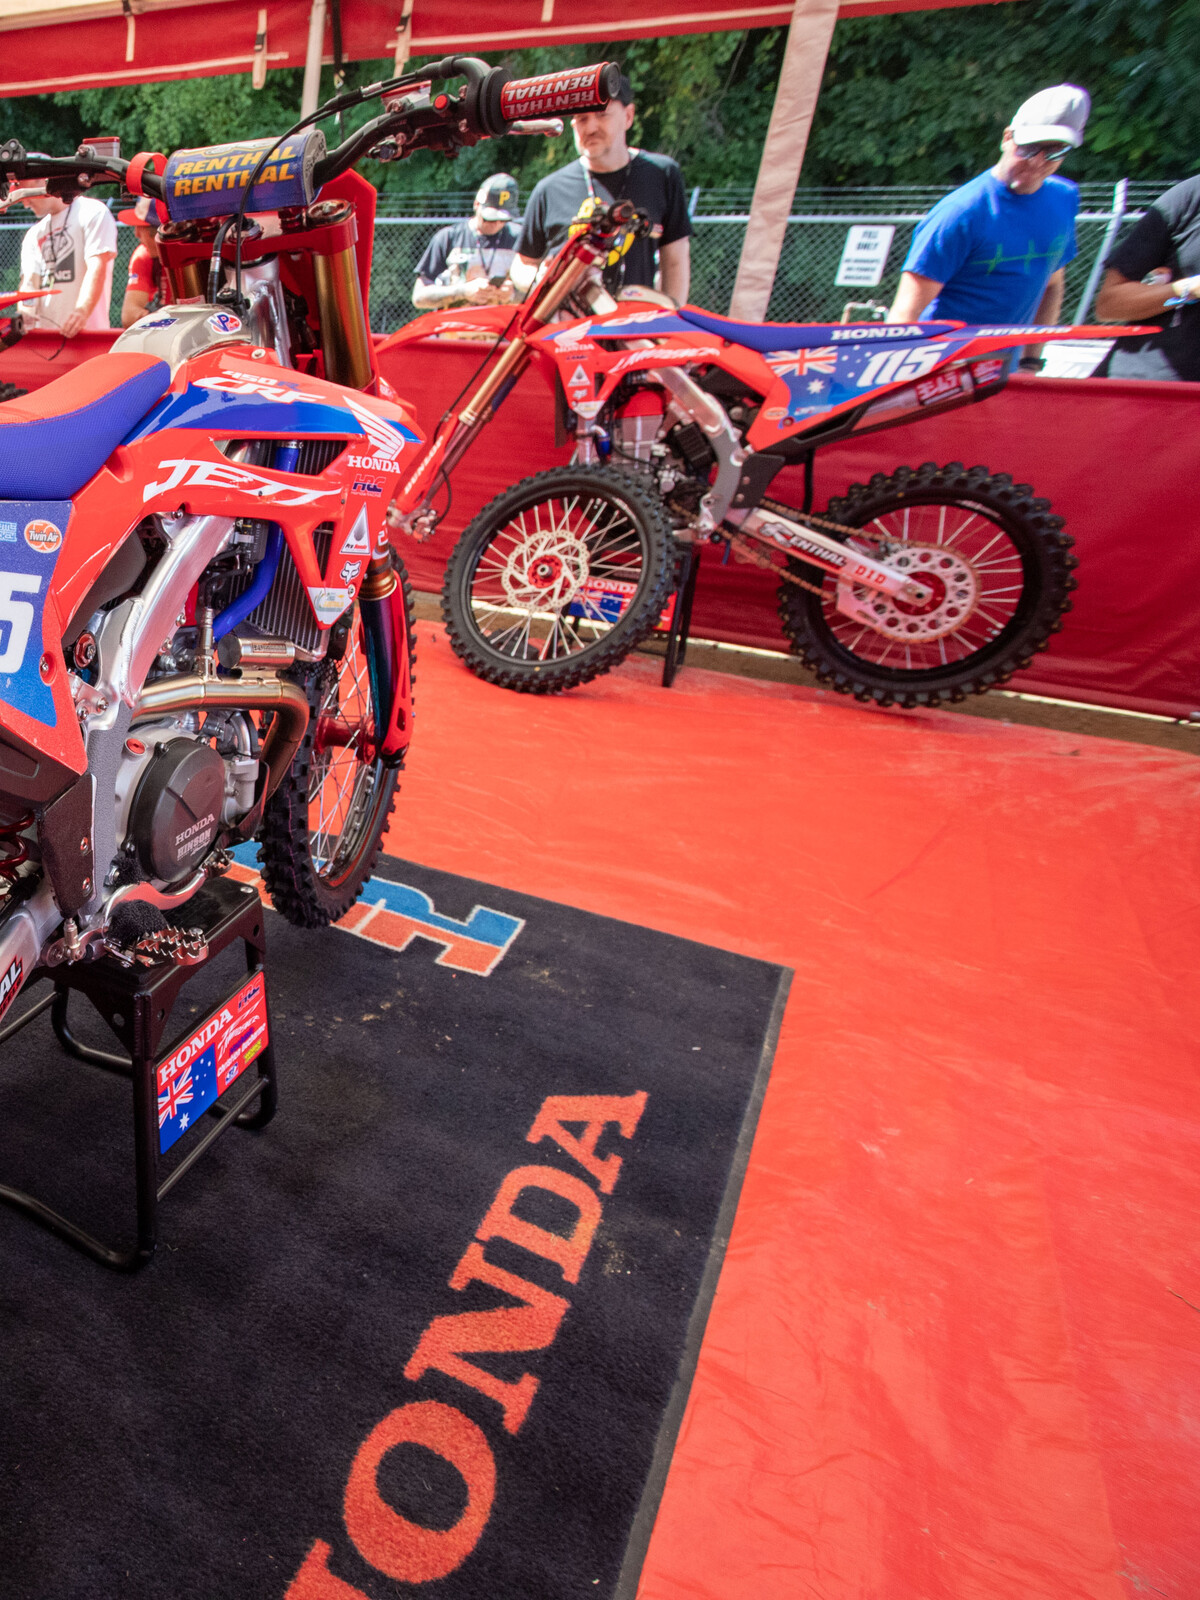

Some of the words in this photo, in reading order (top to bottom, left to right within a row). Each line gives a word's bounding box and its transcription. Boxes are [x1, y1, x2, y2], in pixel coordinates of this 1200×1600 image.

[505, 73, 596, 101] RENTHAL
[504, 89, 594, 116] RENTHAL
[173, 146, 297, 177] RENTHAL
[174, 163, 296, 197] RENTHAL
[499, 191, 510, 206] P
[832, 325, 924, 342] HONDA
[856, 342, 950, 387] 115
[192, 377, 326, 404] CRF
[347, 455, 401, 474] HONDA
[142, 459, 342, 506] JETT
[175, 813, 215, 846] HONDA
[159, 1008, 234, 1086] HONDA
